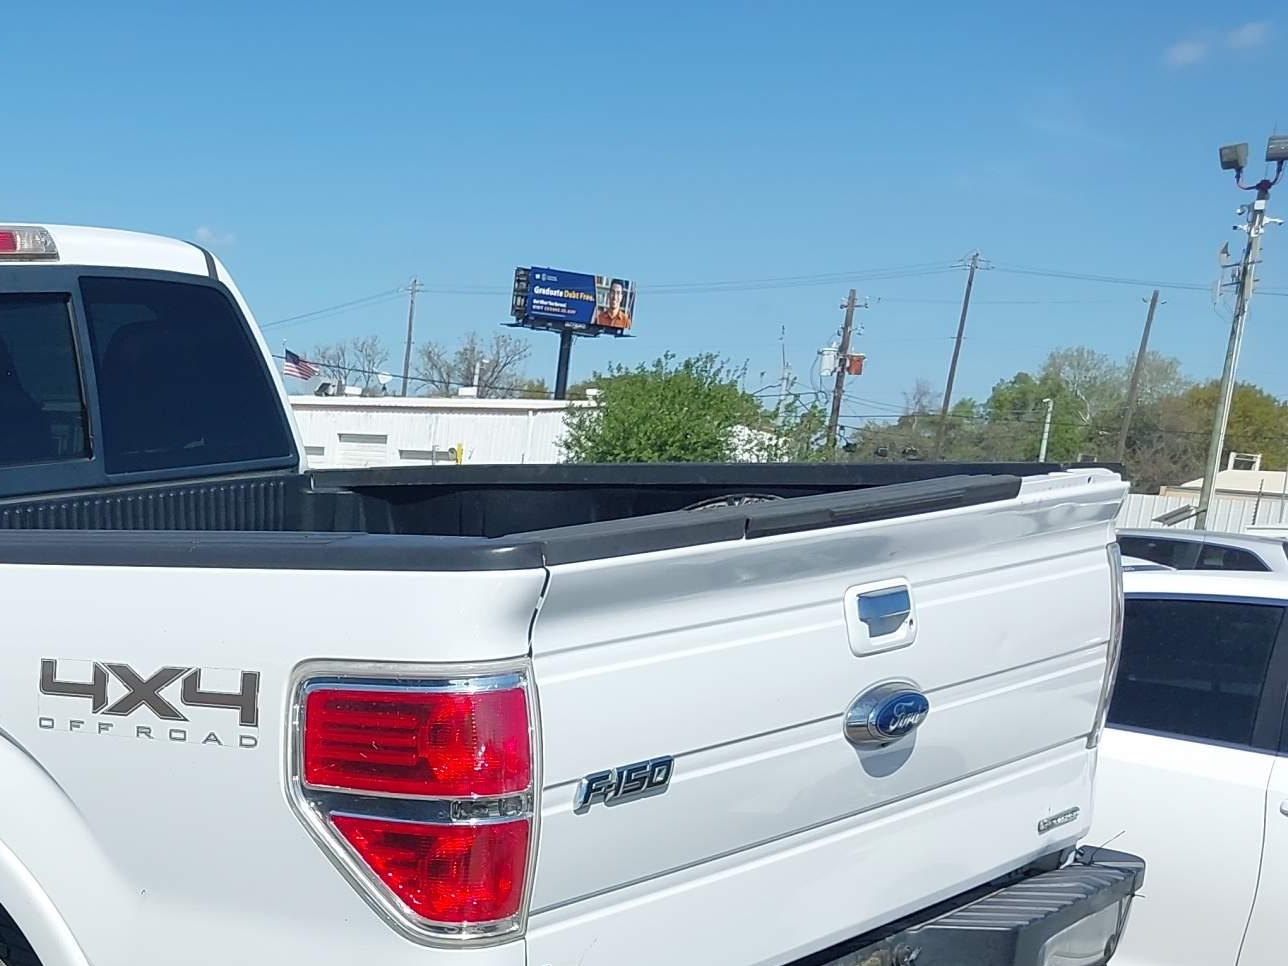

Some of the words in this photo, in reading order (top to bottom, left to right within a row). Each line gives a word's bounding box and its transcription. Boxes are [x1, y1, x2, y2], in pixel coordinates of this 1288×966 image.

[533, 285, 564, 297] Graduate
[564, 290, 579, 300] Debt
[887, 700, 926, 732] Ford
[573, 755, 674, 815] F-150
